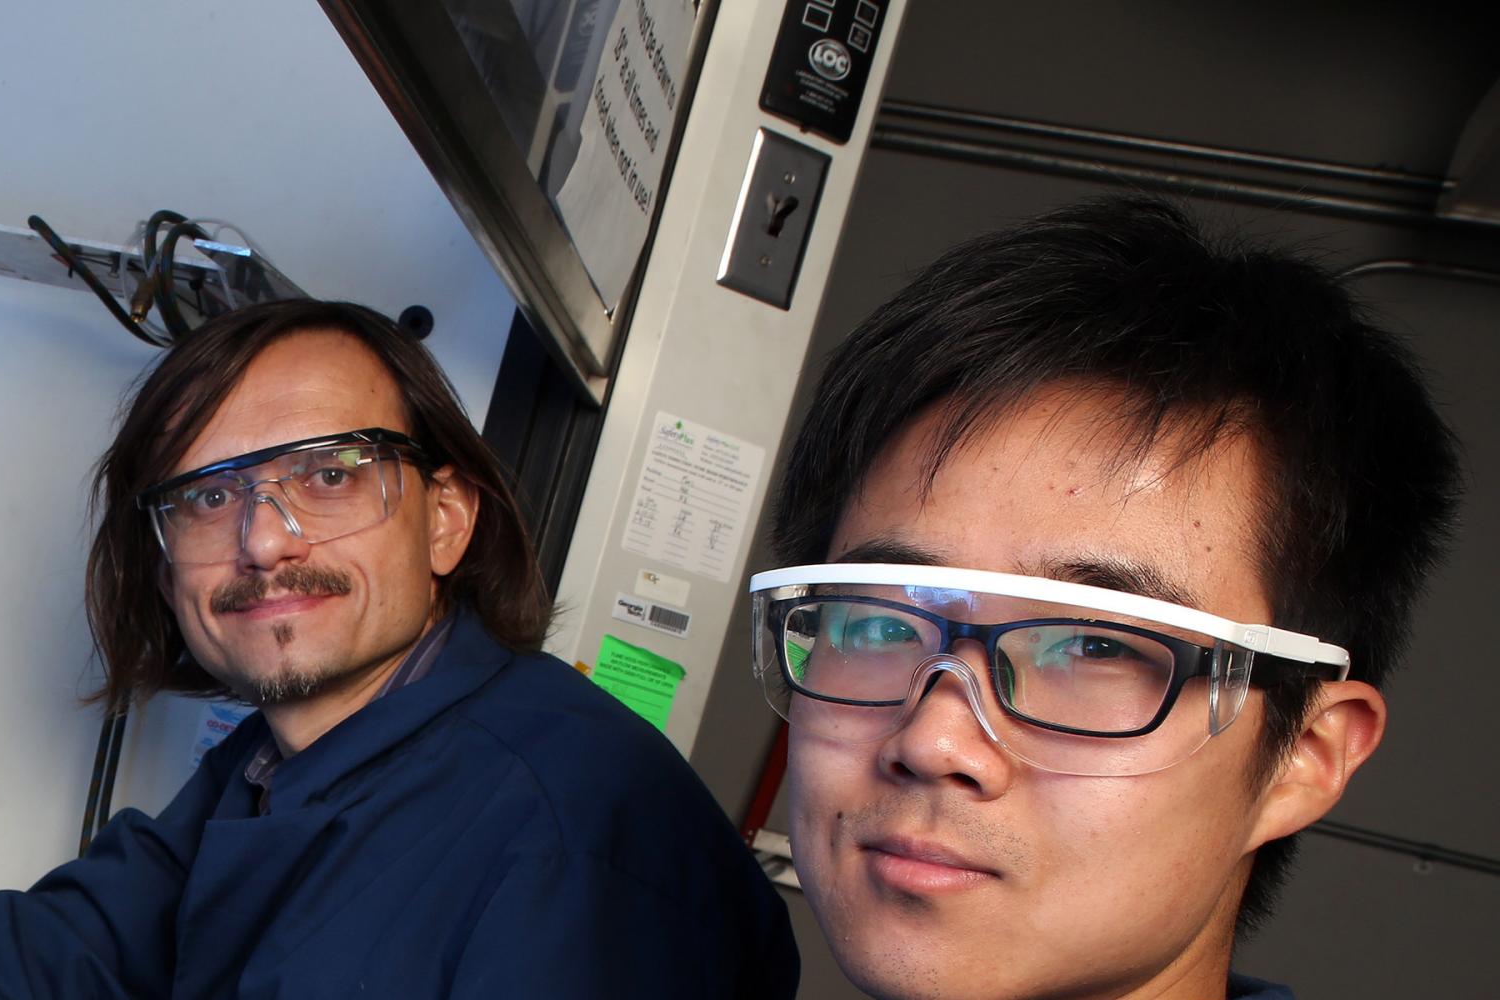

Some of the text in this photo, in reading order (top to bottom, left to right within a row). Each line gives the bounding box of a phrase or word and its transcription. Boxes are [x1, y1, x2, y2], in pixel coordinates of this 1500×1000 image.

[813, 45, 848, 74] LOC
[617, 148, 631, 181] not
[627, 161, 637, 193] in
